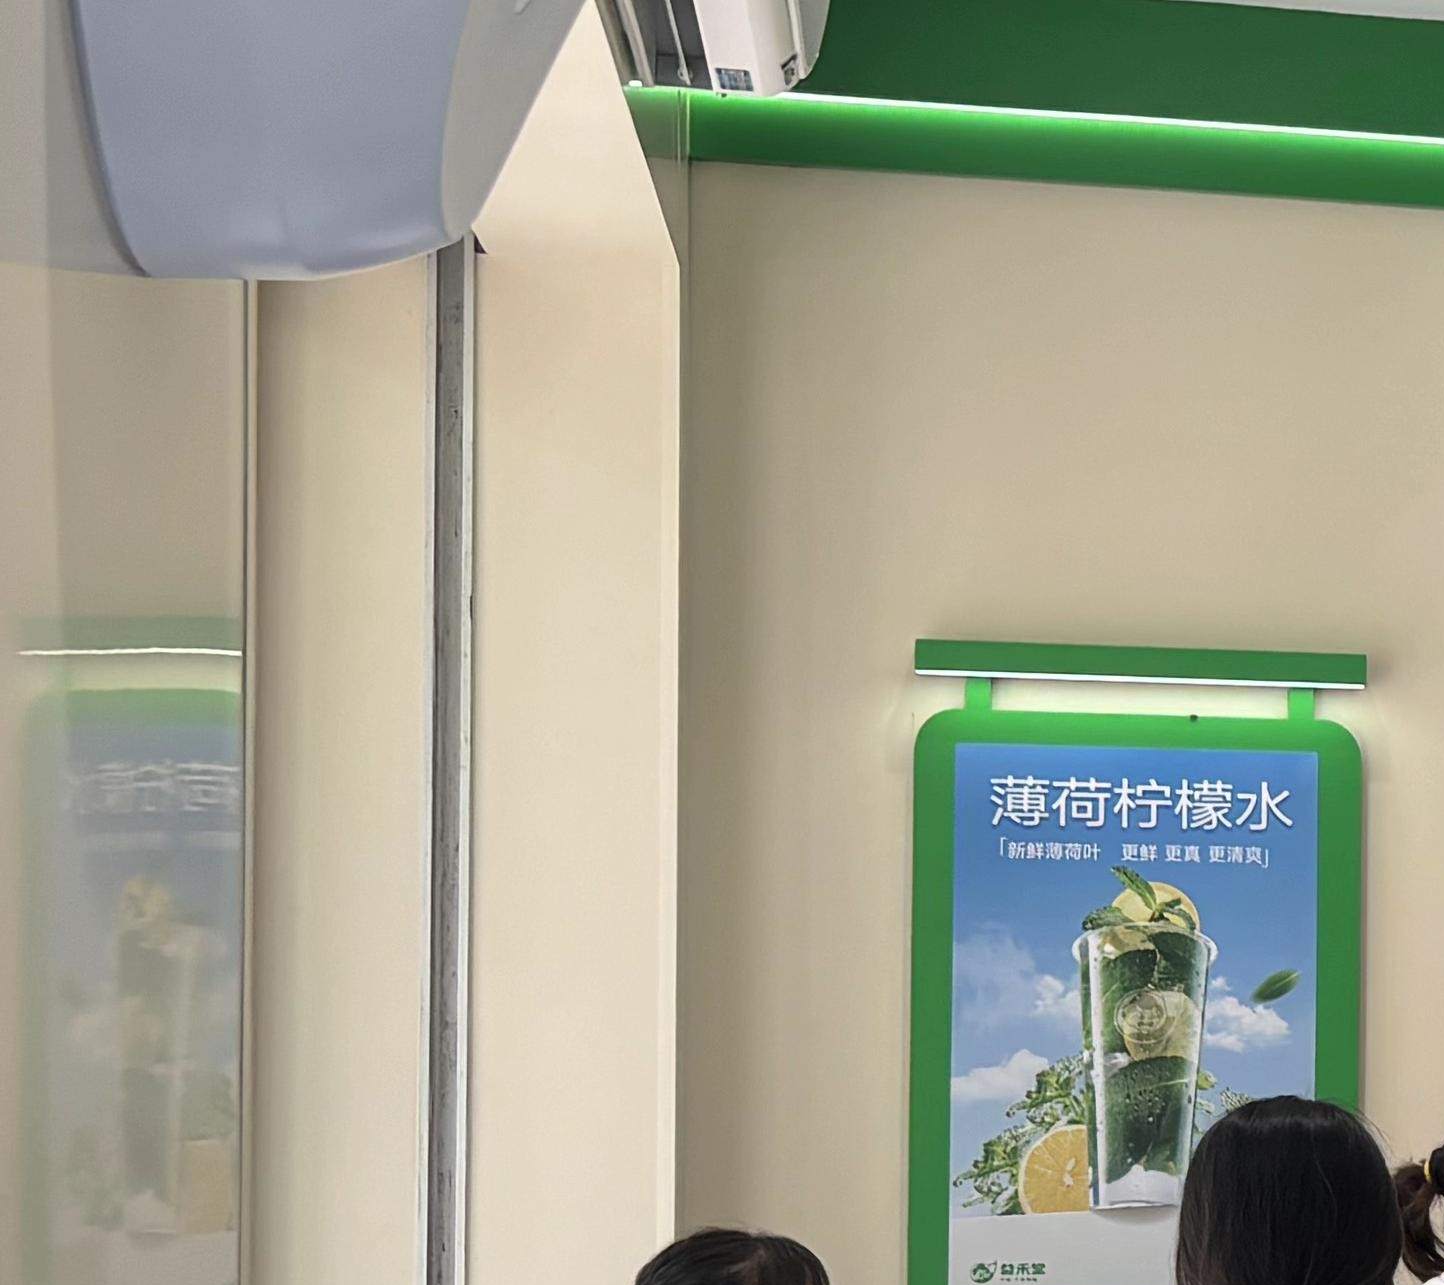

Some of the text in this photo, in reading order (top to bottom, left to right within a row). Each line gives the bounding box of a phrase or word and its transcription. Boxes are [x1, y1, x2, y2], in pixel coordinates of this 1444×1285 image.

[990, 775, 1294, 832] 薄荷柠檬水
[1121, 843, 1158, 862] 更鲜
[1165, 844, 1201, 864] 更真
